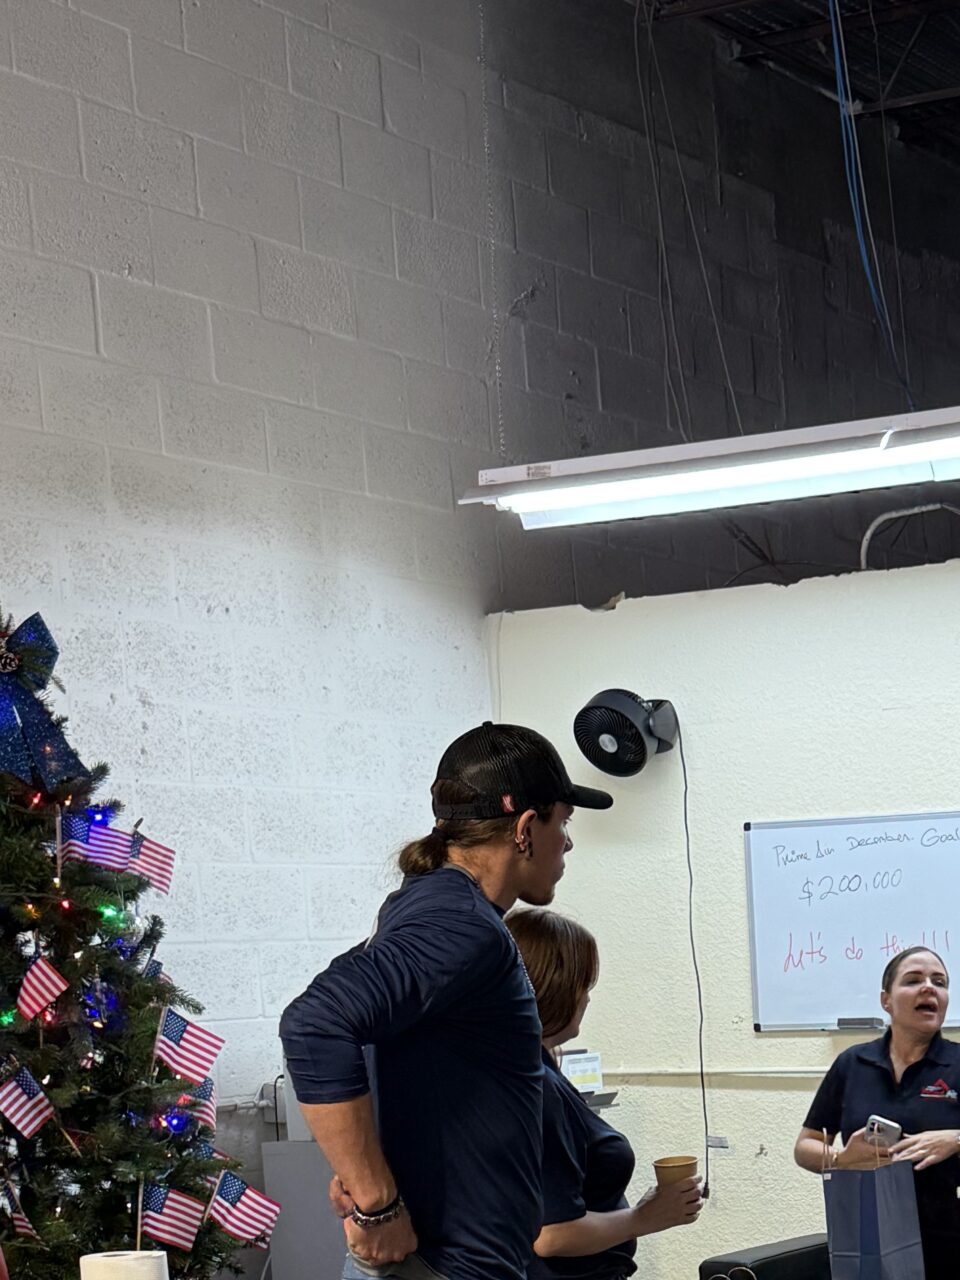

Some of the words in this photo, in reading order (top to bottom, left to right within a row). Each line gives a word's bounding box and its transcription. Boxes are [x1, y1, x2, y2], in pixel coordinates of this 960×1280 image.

[773, 845, 811, 867] Prime
[920, 828, 960, 847] Goal
[799, 869, 902, 905] $200,000
[784, 931, 828, 972] Let's
[845, 937, 863, 960] do
